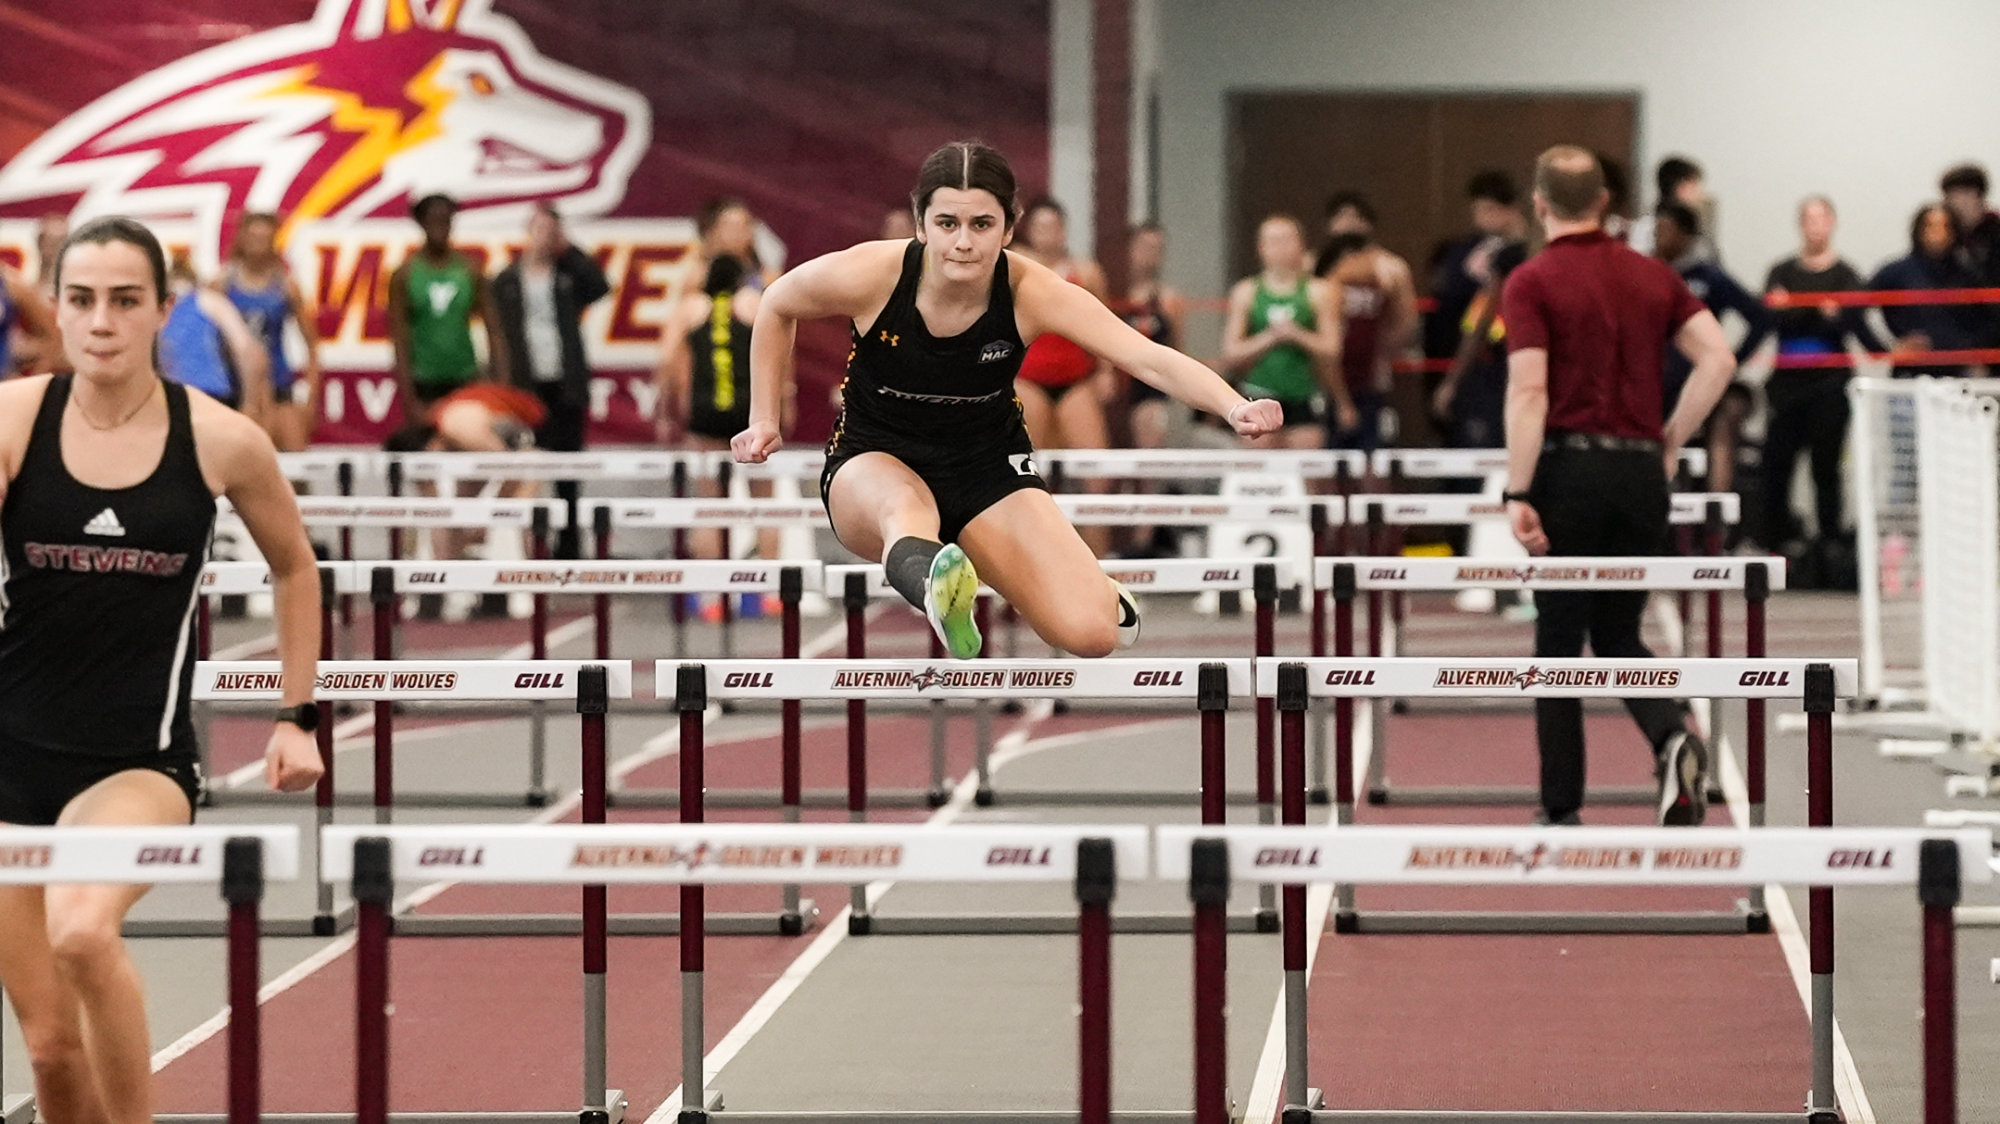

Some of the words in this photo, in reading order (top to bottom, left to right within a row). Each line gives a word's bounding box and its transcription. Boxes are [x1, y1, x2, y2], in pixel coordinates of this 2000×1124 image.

[981, 349, 1010, 361] MAC
[24, 542, 188, 576] STEVENS
[409, 571, 447, 584] GILL
[730, 571, 767, 584] GILL
[1203, 570, 1240, 582] GILL
[1369, 568, 1407, 581] GILL
[1693, 568, 1731, 580] GILL
[215, 673, 284, 690] ALVERNI
[323, 673, 386, 690] GOLDEN
[392, 673, 456, 689] WOLVES
[514, 673, 565, 689] GILL
[723, 672, 774, 688] GILL
[834, 671, 912, 688] ALVERNIA
[942, 671, 1005, 688] GOLDEN
[1011, 671, 1075, 688] WOLVES
[1133, 671, 1184, 686] GILL
[1325, 670, 1376, 686] GILL
[1437, 669, 1514, 686] ALVERNIA
[1545, 669, 1608, 686] GOLDEN
[1615, 670, 1680, 687] WOLVES
[1738, 671, 1790, 687] GILL
[136, 846, 201, 865] GILL
[419, 847, 485, 866] GILL
[986, 847, 1050, 866] GILL
[1254, 848, 1319, 866] GILL
[1828, 848, 1894, 868] GILL
